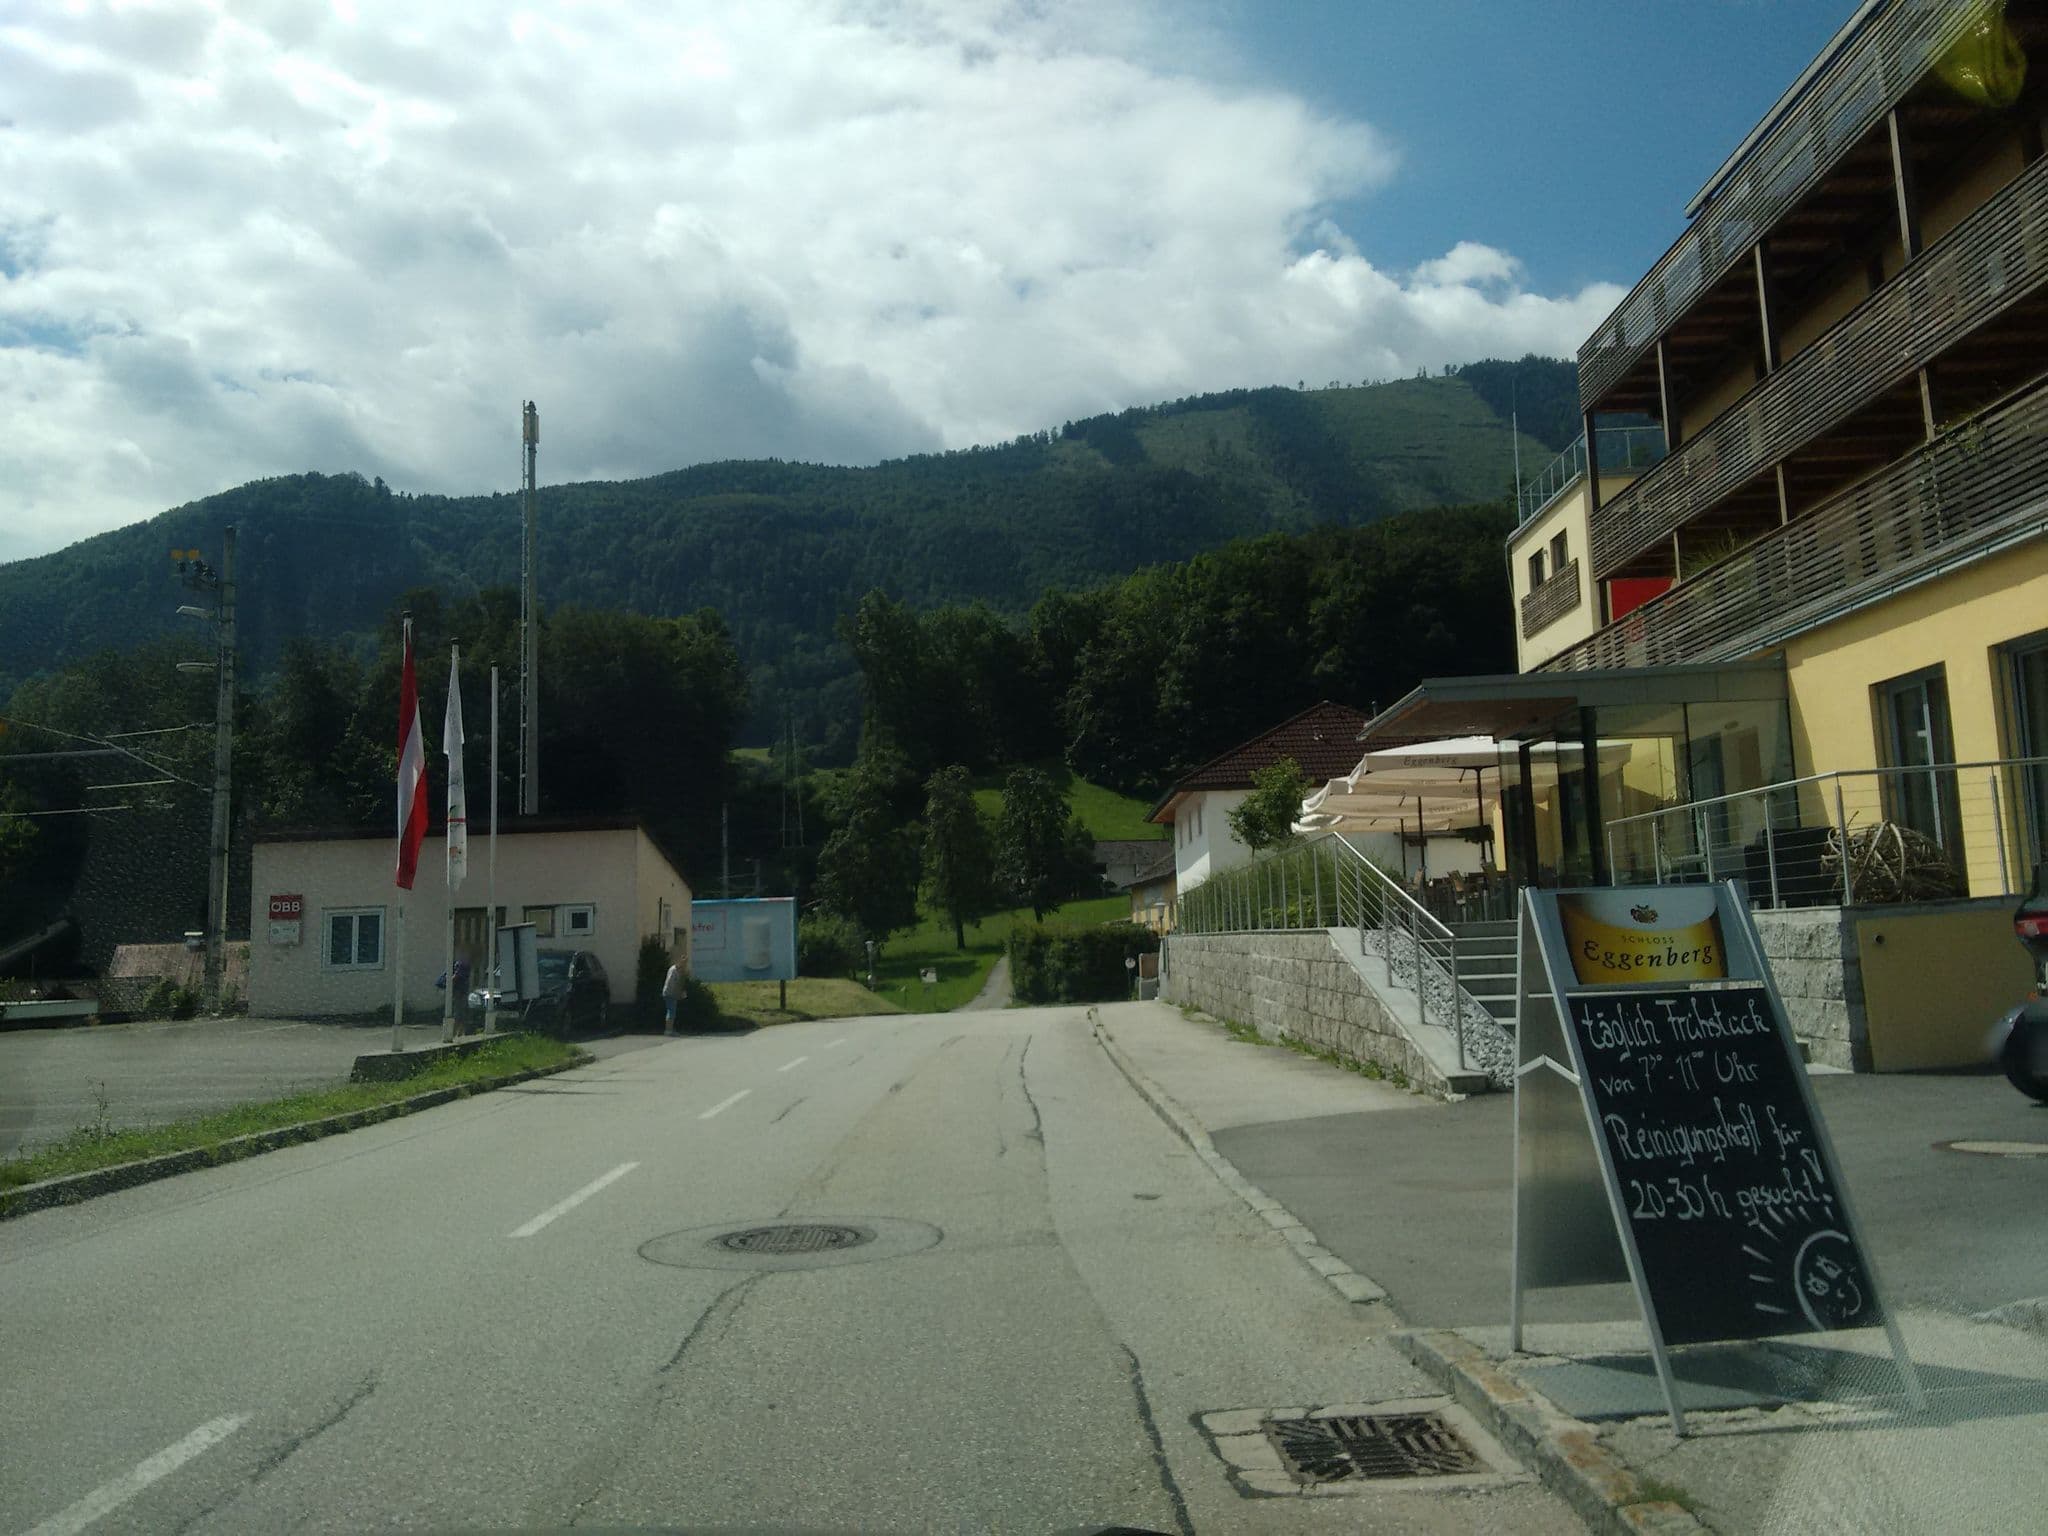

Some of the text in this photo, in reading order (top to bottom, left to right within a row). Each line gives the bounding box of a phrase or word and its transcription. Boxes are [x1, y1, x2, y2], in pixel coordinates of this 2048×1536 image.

[1584, 939, 1713, 971] Eggenberg
[1621, 935, 1675, 945] SCHLOSS
[1581, 997, 1770, 1062] täglich Frühstück
[1600, 1075, 1636, 1097] von
[1714, 1050, 1759, 1083] Uhr
[1603, 1096, 1802, 1167] Reinigungskraft für
